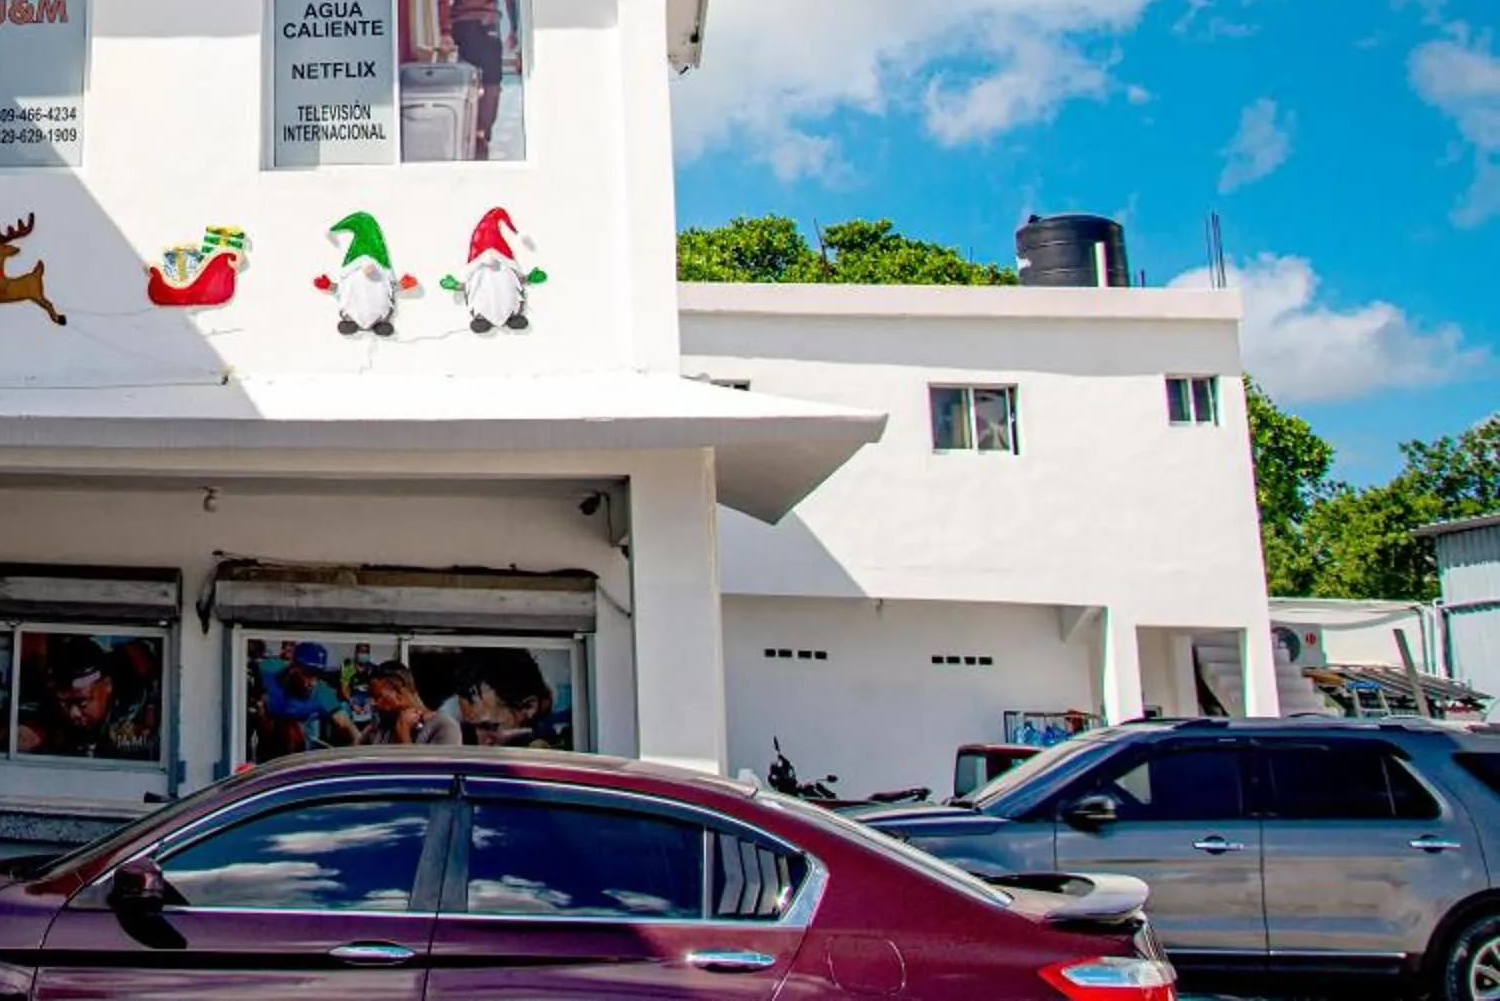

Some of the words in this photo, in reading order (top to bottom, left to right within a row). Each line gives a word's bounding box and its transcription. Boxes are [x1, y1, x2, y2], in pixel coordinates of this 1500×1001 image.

[303, 2, 363, 19] AGUA
[283, 20, 384, 39] CALIENTE
[291, 61, 376, 79] NETFLIX
[297, 101, 371, 122] TELEVISIÓN
[283, 123, 386, 142] INTERNACIONAL
